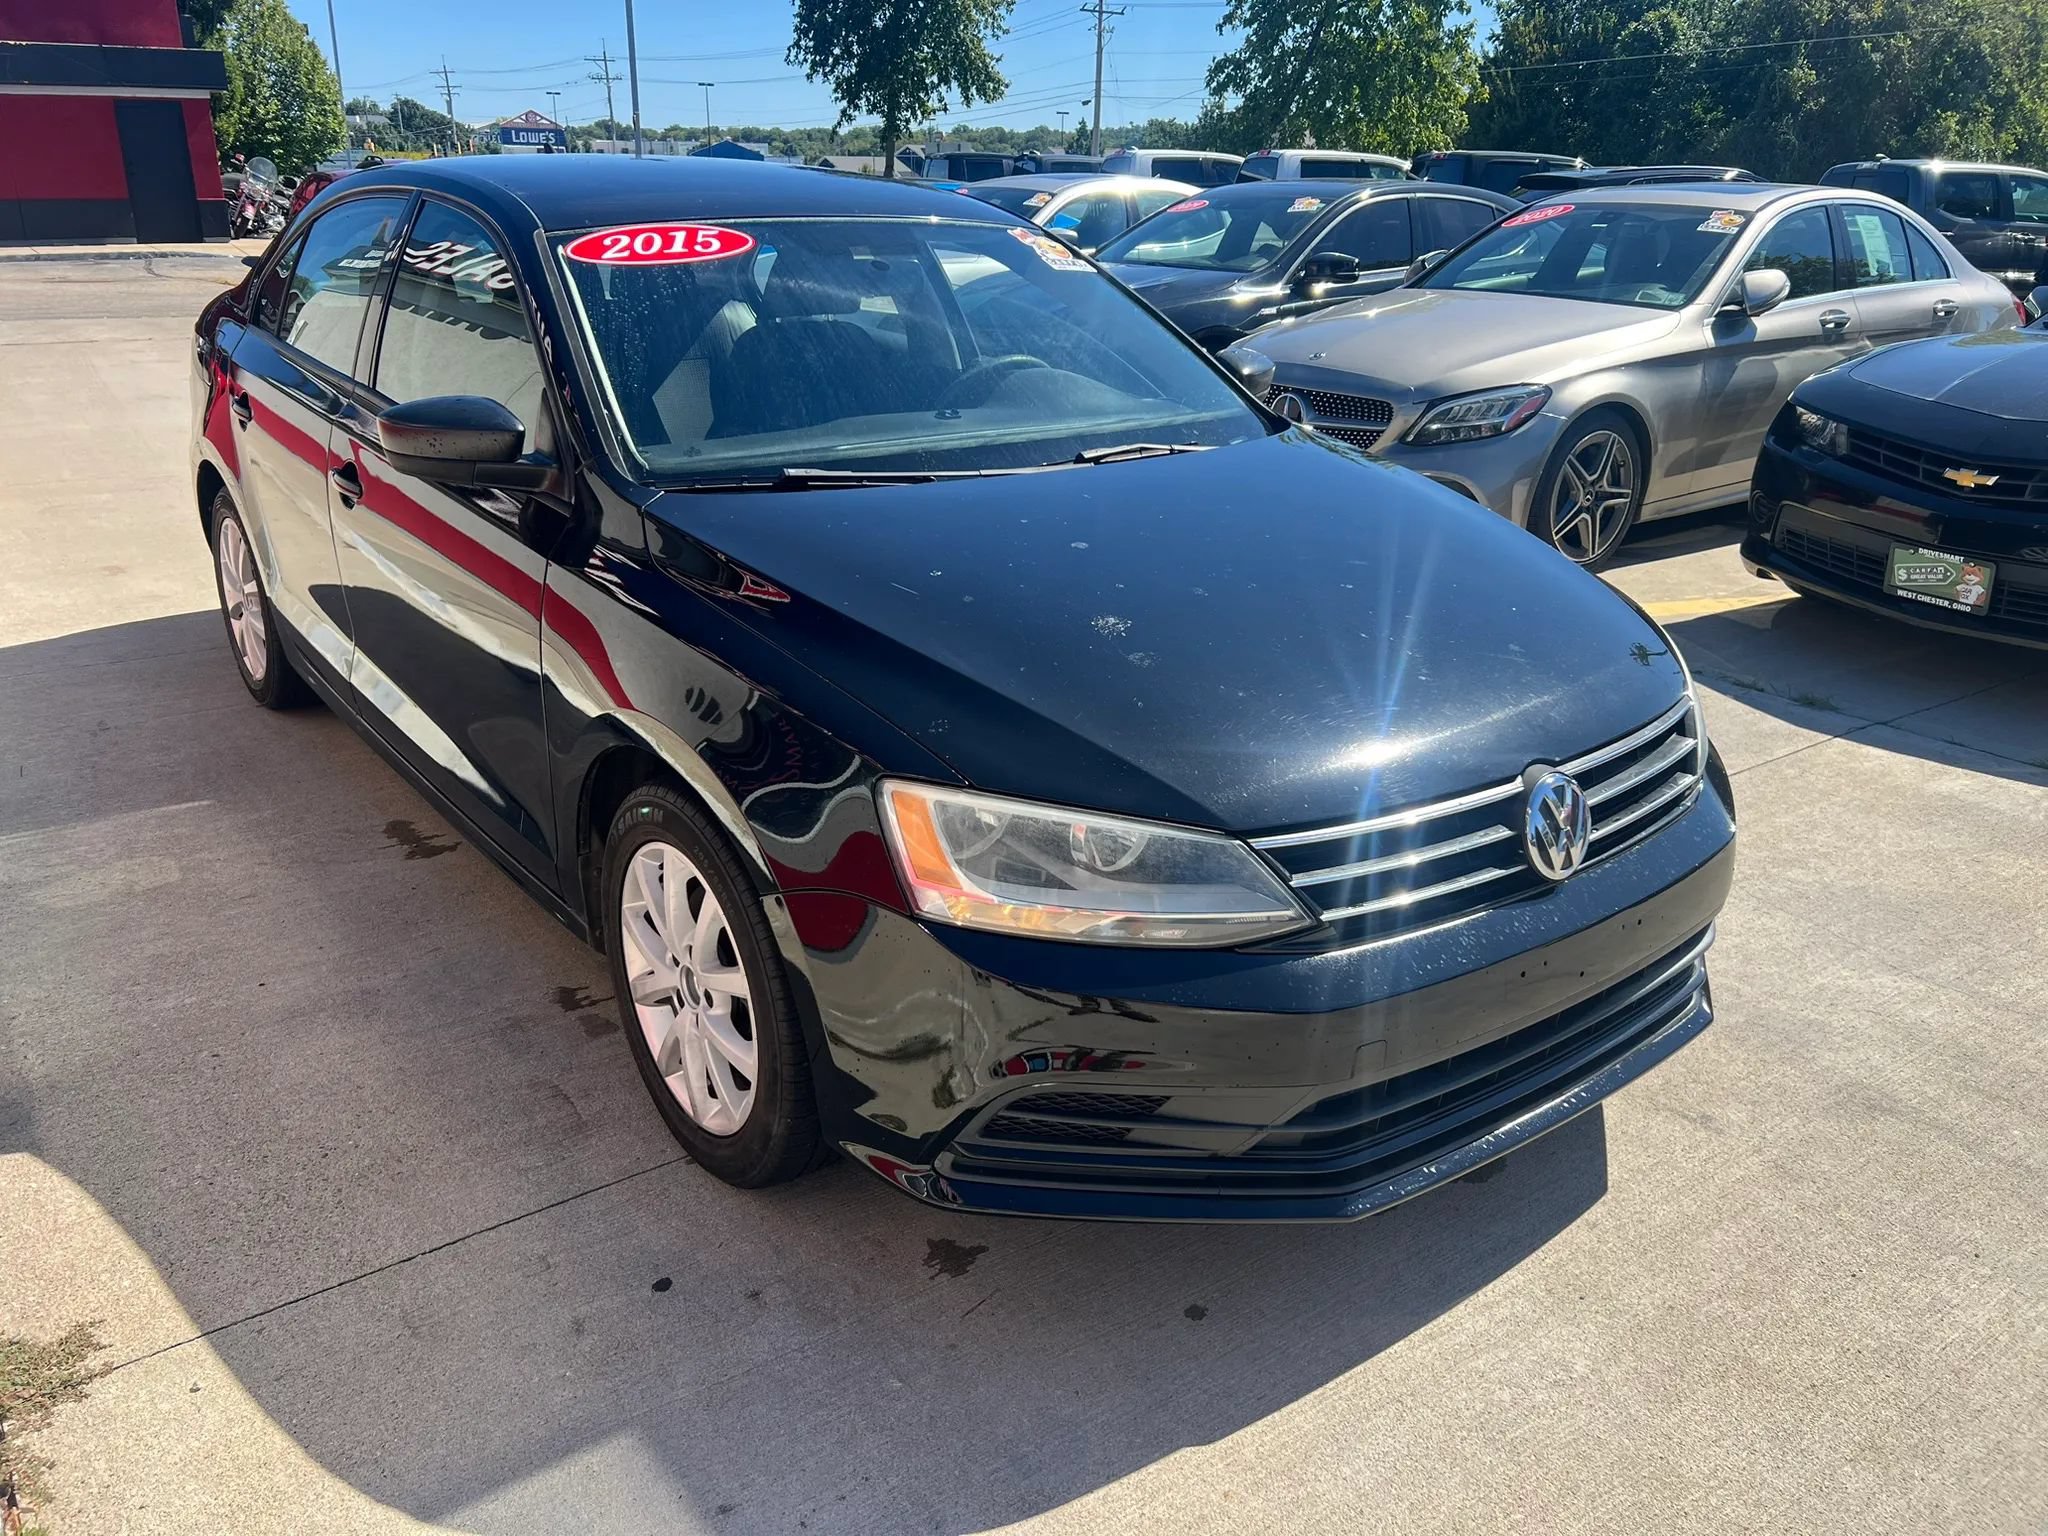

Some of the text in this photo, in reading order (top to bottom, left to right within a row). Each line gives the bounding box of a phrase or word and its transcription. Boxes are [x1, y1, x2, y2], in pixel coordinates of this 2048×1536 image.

[511, 129, 556, 144] LOWE'S
[600, 229, 722, 260] 2015
[1918, 548, 1965, 563] DRIVESMART
[1896, 589, 1972, 612] WEST CHESTER, OHIO
